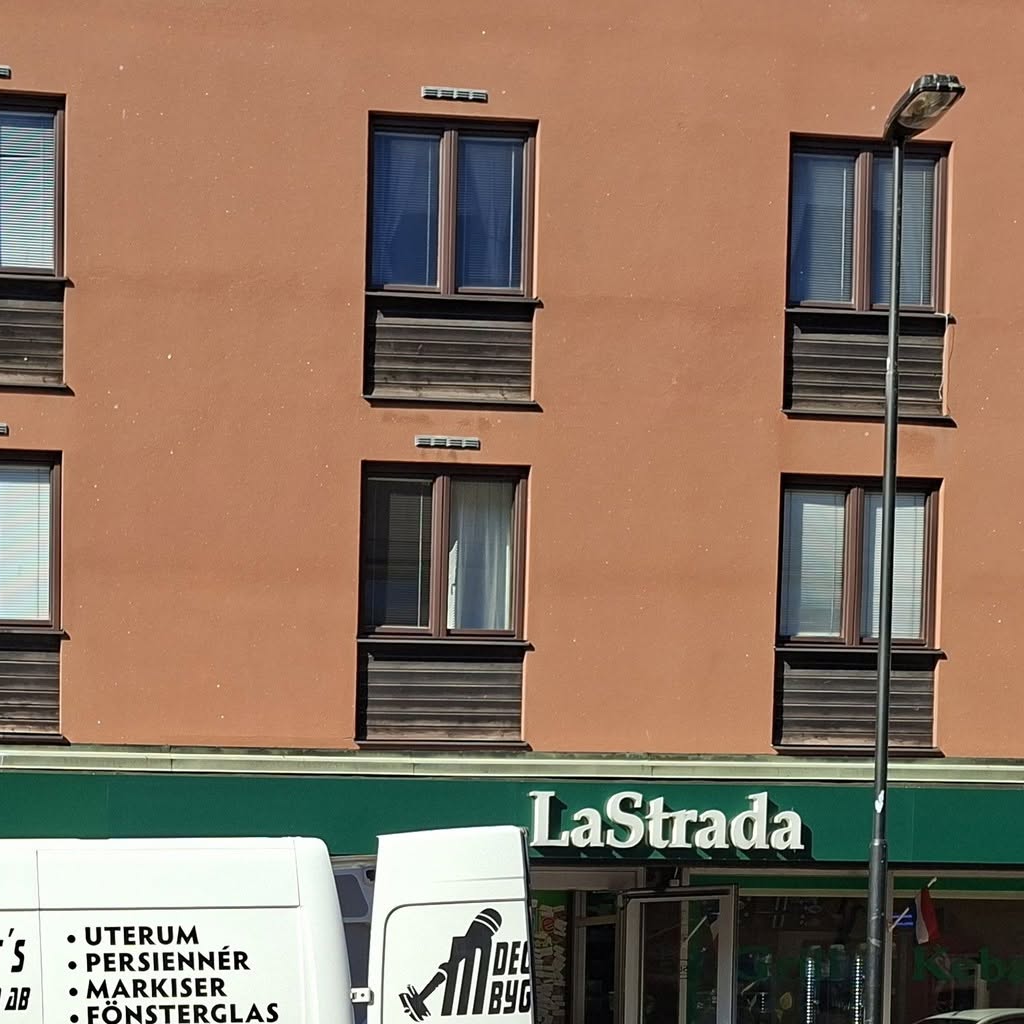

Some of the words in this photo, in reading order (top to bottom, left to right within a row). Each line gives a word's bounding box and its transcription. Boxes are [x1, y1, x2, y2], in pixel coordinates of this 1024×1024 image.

[528, 790, 805, 851] LaStrada
[85, 925, 199, 946] UTERUM
[86, 945, 251, 972] PERSIENNÉR
[86, 978, 227, 999] MARKISER
